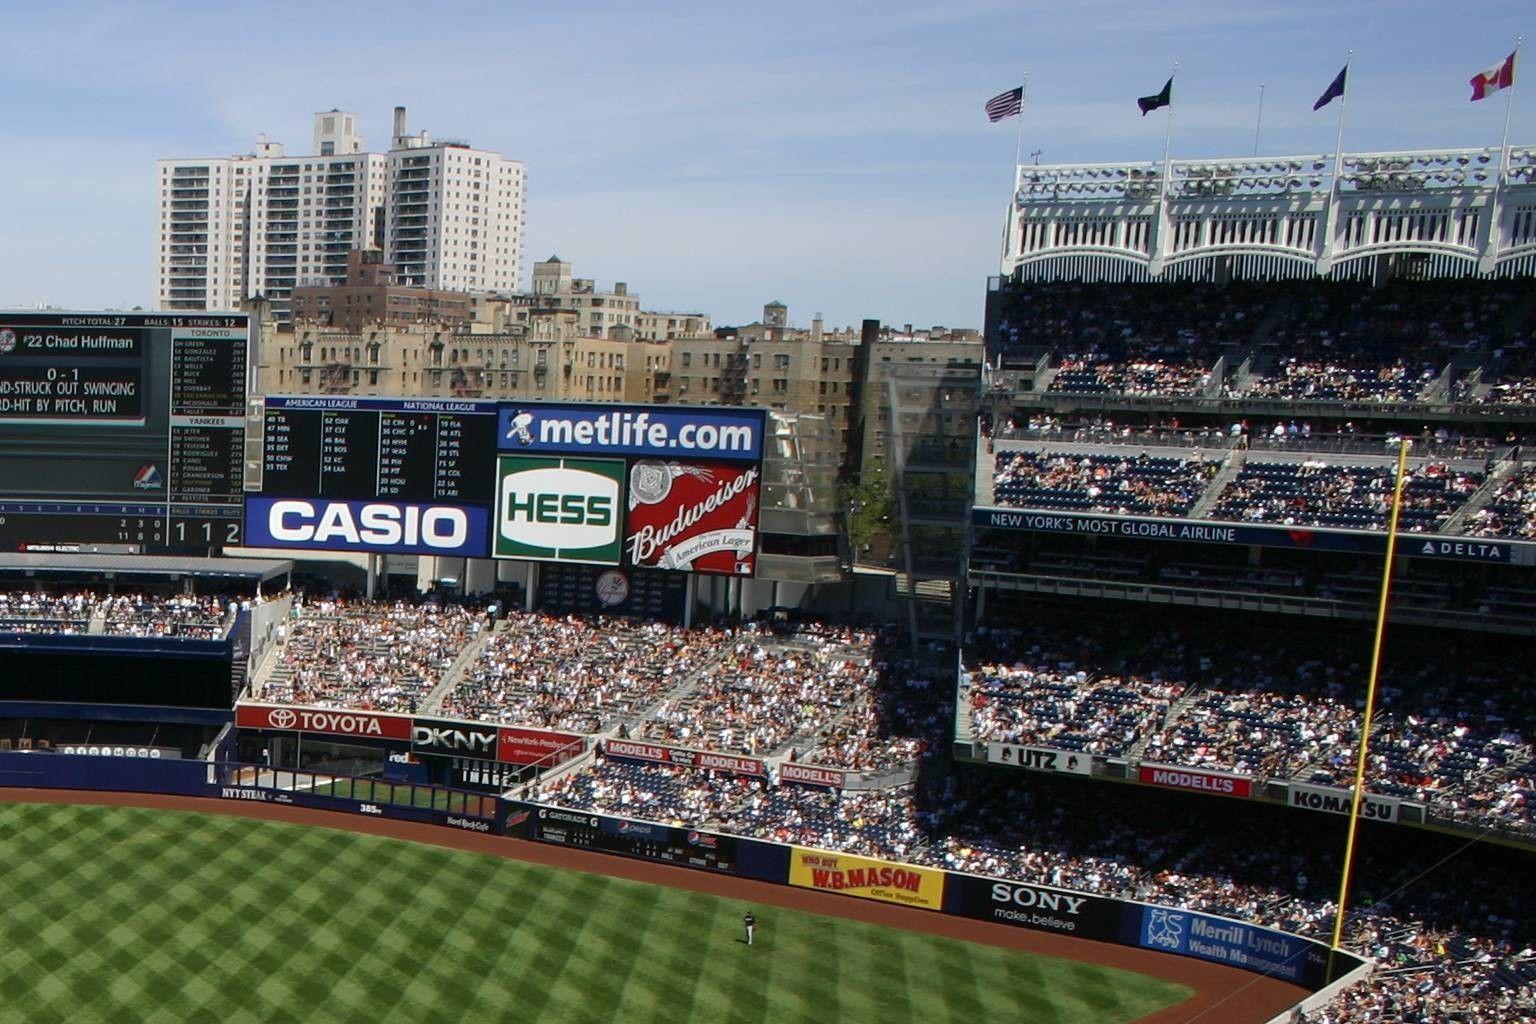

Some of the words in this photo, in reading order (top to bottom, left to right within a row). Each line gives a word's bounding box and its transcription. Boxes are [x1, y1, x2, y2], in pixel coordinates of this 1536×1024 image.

[61, 318, 86, 326] PITCH
[113, 318, 126, 326] 27
[172, 318, 183, 327] 15
[224, 319, 236, 327] 12
[23, 335, 43, 349] #22
[45, 334, 76, 349] Chad
[80, 336, 134, 350] Huffman
[190, 329, 231, 337] TORONTO
[47, 368, 56, 381] 0
[71, 368, 79, 381] 1
[56, 382, 79, 395] OUT
[83, 382, 135, 396] SWINGING
[35, 399, 49, 412] BY
[54, 399, 88, 414] PITCH,
[92, 400, 117, 413] RUN
[285, 399, 327, 408] AMERICAN
[327, 400, 358, 409] LEAGUE
[403, 401, 444, 411] NATIONAL
[445, 403, 476, 412] LEAGUE
[539, 412, 753, 451] metlife.com
[507, 491, 612, 527] HESS
[626, 465, 760, 566] Budweiser
[176, 522, 186, 541] 1
[202, 522, 212, 542] 1
[226, 523, 239, 543] 2
[268, 500, 468, 546] CASIO
[990, 513, 1022, 527] NEW
[1026, 515, 1074, 531] YORK'S
[1077, 519, 1119, 534] MOST
[1121, 521, 1176, 538] GLOBAL
[1179, 525, 1236, 542] AIRLINE
[118, 532, 129, 541] 11
[675, 536, 720, 561] American
[721, 535, 751, 548] Lager
[1439, 540, 1501, 559] DELTA
[300, 711, 382, 735] TOYOTA
[414, 727, 496, 752] DKNY
[609, 742, 663, 759] MODELL'S
[1017, 747, 1057, 770] UTZ
[700, 754, 757, 772] MODELL'S
[782, 766, 842, 784] MODELL'S
[1153, 769, 1234, 794] MODELL'S
[222, 788, 241, 799] NYY
[241, 789, 266, 801] STEAK
[1294, 791, 1392, 820] KOMASU
[801, 855, 819, 867] WHO
[820, 856, 838, 868] BUT
[870, 888, 894, 900] Office
[894, 891, 929, 905] Supplies
[991, 884, 1087, 915] SONY
[994, 908, 1076, 931] make.believe
[1191, 918, 1244, 944] Merrill
[1248, 931, 1290, 958] Lynch
[1188, 939, 1228, 959] Wealth
[1229, 948, 1296, 978] Management
